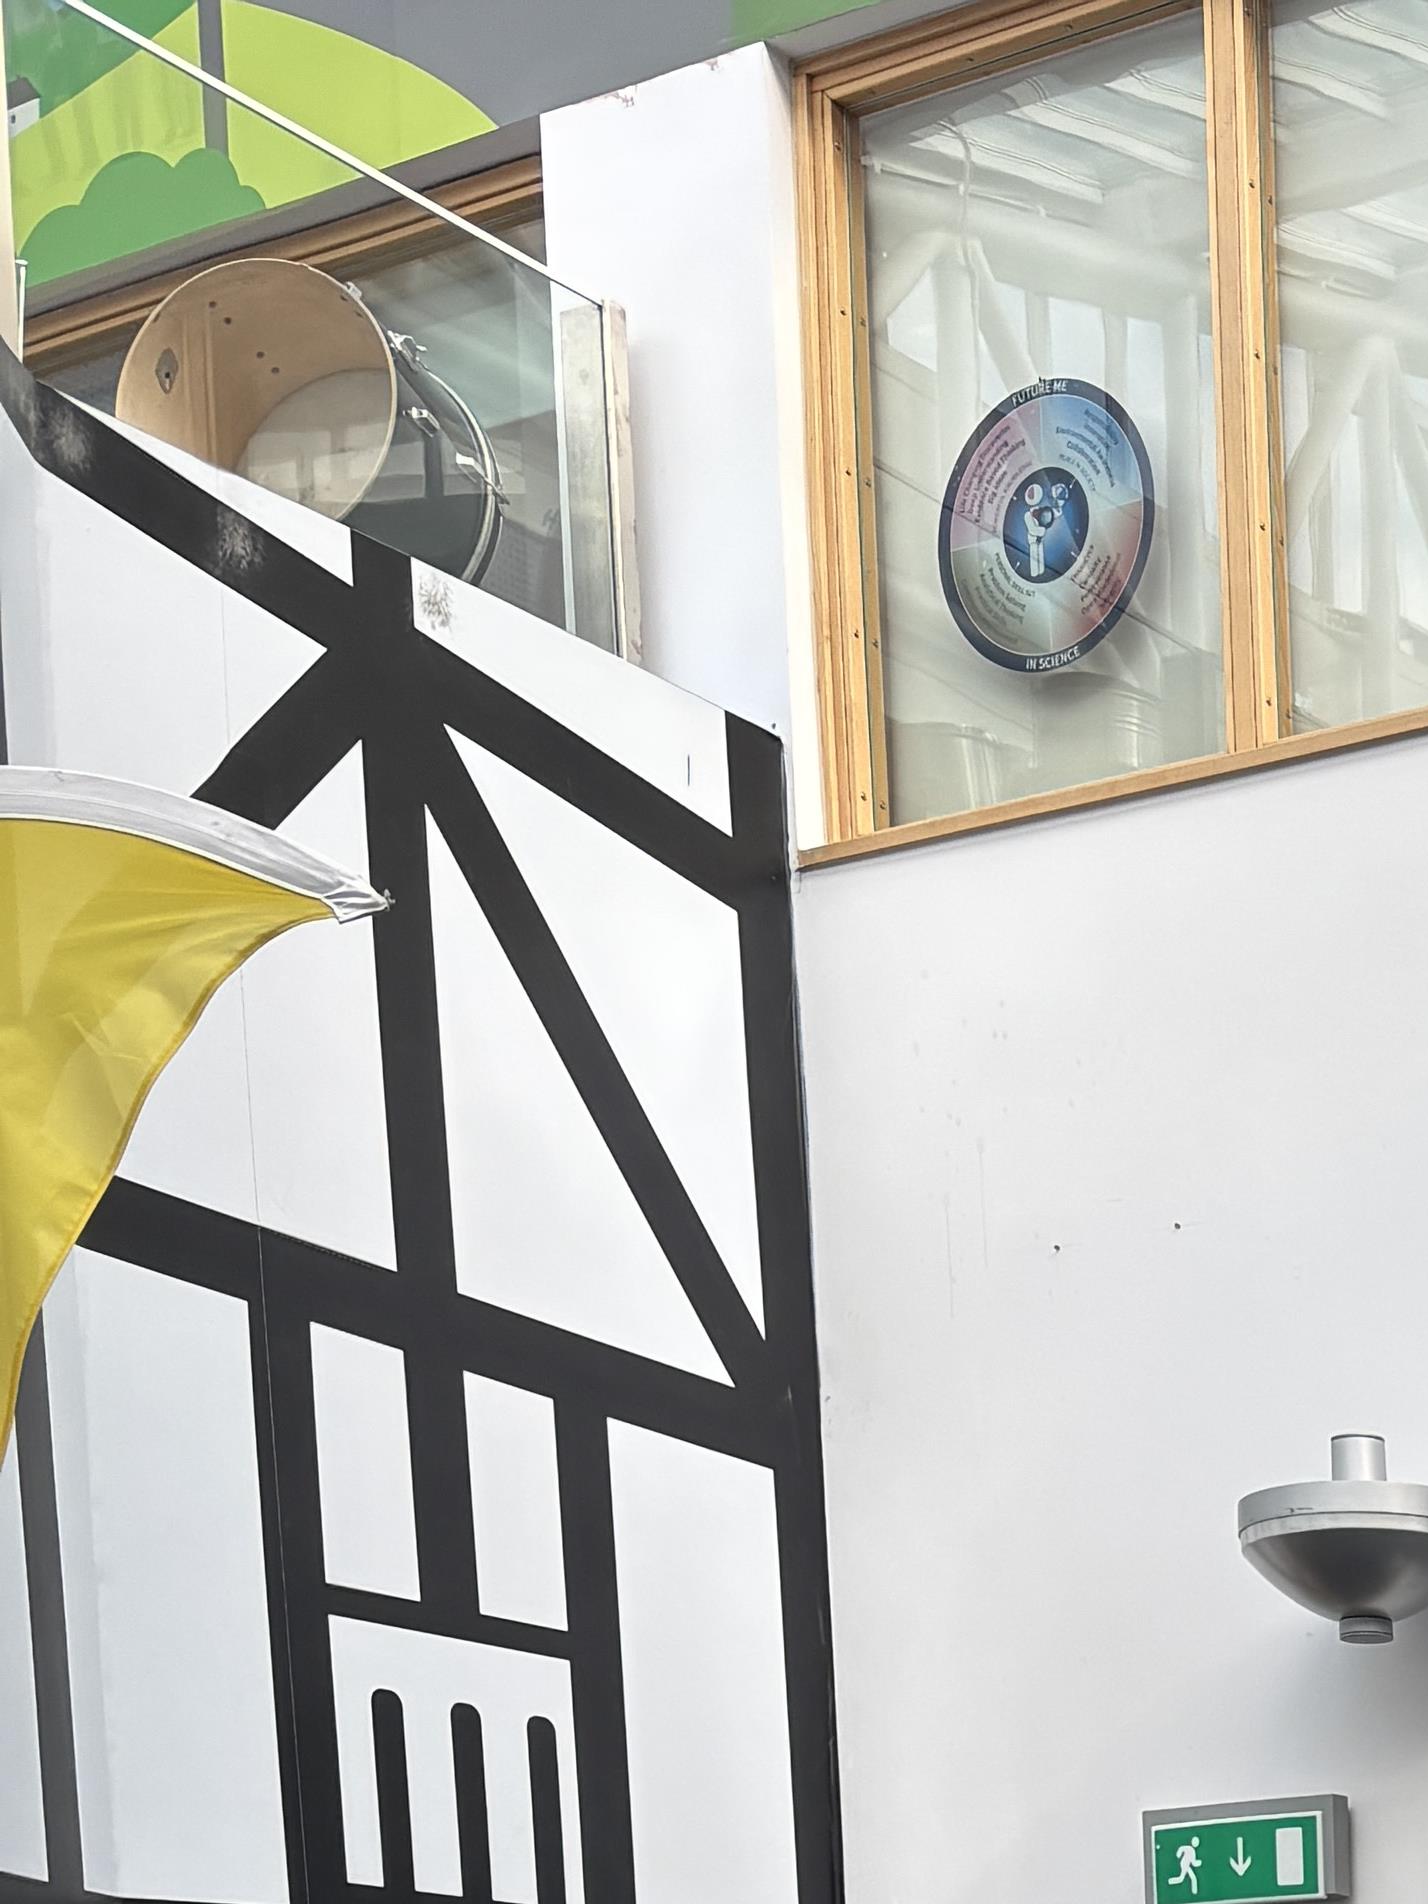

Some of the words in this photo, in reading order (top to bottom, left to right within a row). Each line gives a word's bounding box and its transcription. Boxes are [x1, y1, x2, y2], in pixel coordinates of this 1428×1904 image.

[1011, 381, 1050, 407] FUTURE
[1053, 380, 1068, 392] ME
[1026, 657, 1037, 670] IN
[1039, 646, 1081, 670] SCIENCE
